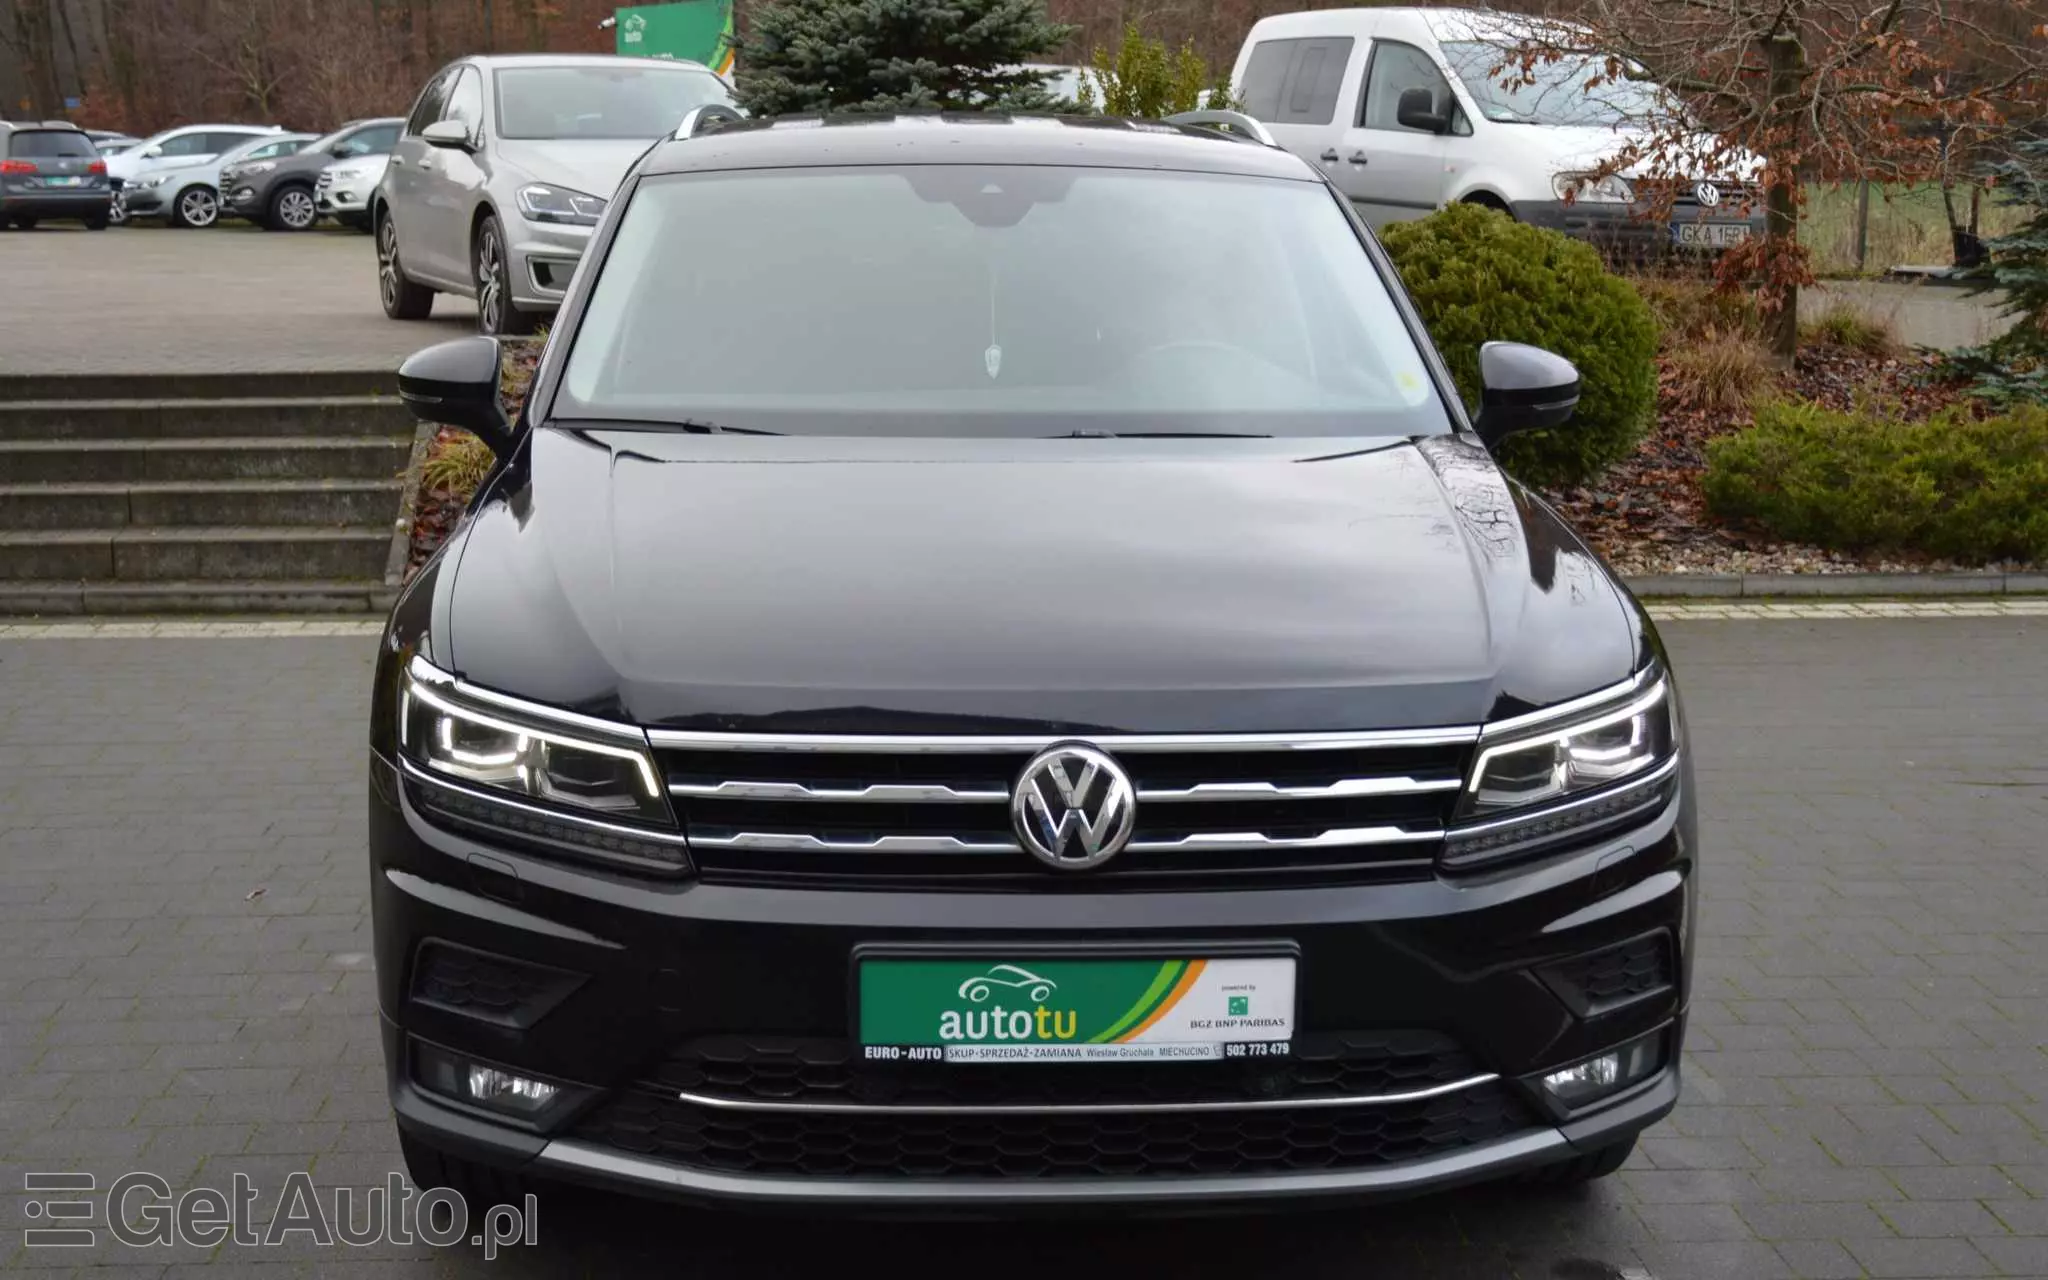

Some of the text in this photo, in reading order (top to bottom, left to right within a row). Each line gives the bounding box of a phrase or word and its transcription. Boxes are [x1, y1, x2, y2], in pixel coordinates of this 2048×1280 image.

[1681, 226, 1711, 242] GKA
[939, 1005, 1077, 1040] autotu
[1215, 1019, 1238, 1028] BNP
[1239, 1018, 1285, 1027] PARIBAS
[864, 1046, 942, 1060] EURO-AUTO
[1226, 1044, 1246, 1056] 502
[1249, 1043, 1268, 1055] 773
[1270, 1042, 1290, 1054] 479
